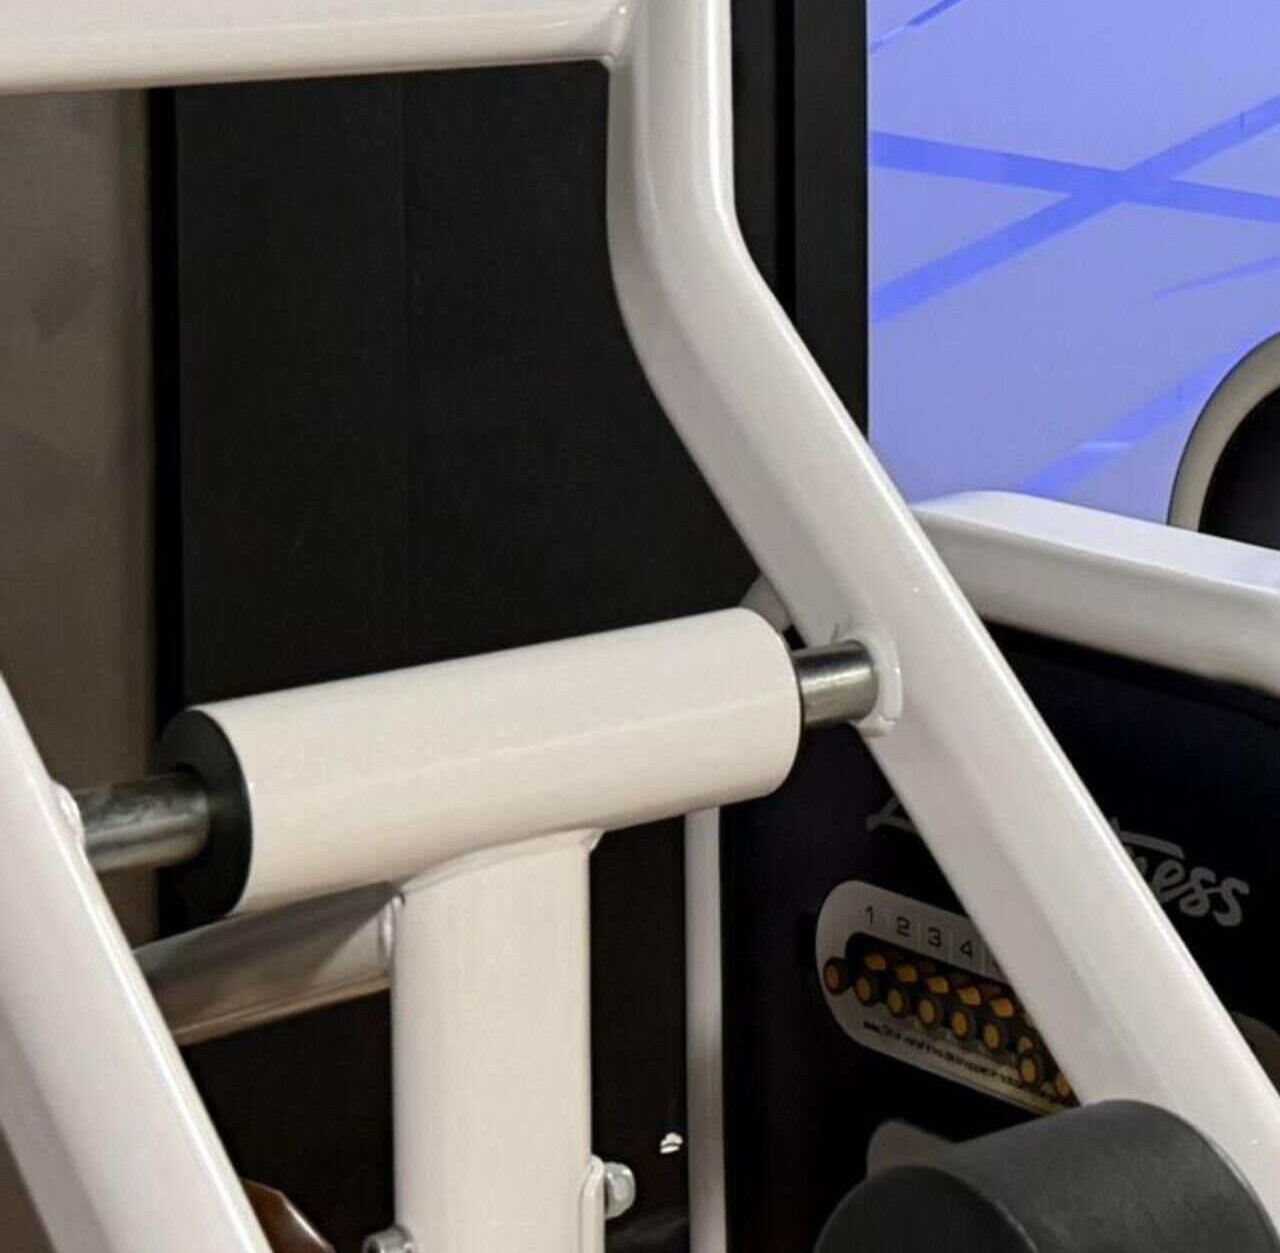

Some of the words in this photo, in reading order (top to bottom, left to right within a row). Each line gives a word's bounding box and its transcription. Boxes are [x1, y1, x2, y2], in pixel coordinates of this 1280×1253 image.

[864, 905, 874, 925] 1
[896, 916, 910, 937] 2
[927, 927, 941, 947] 3
[960, 940, 973, 958] 4
